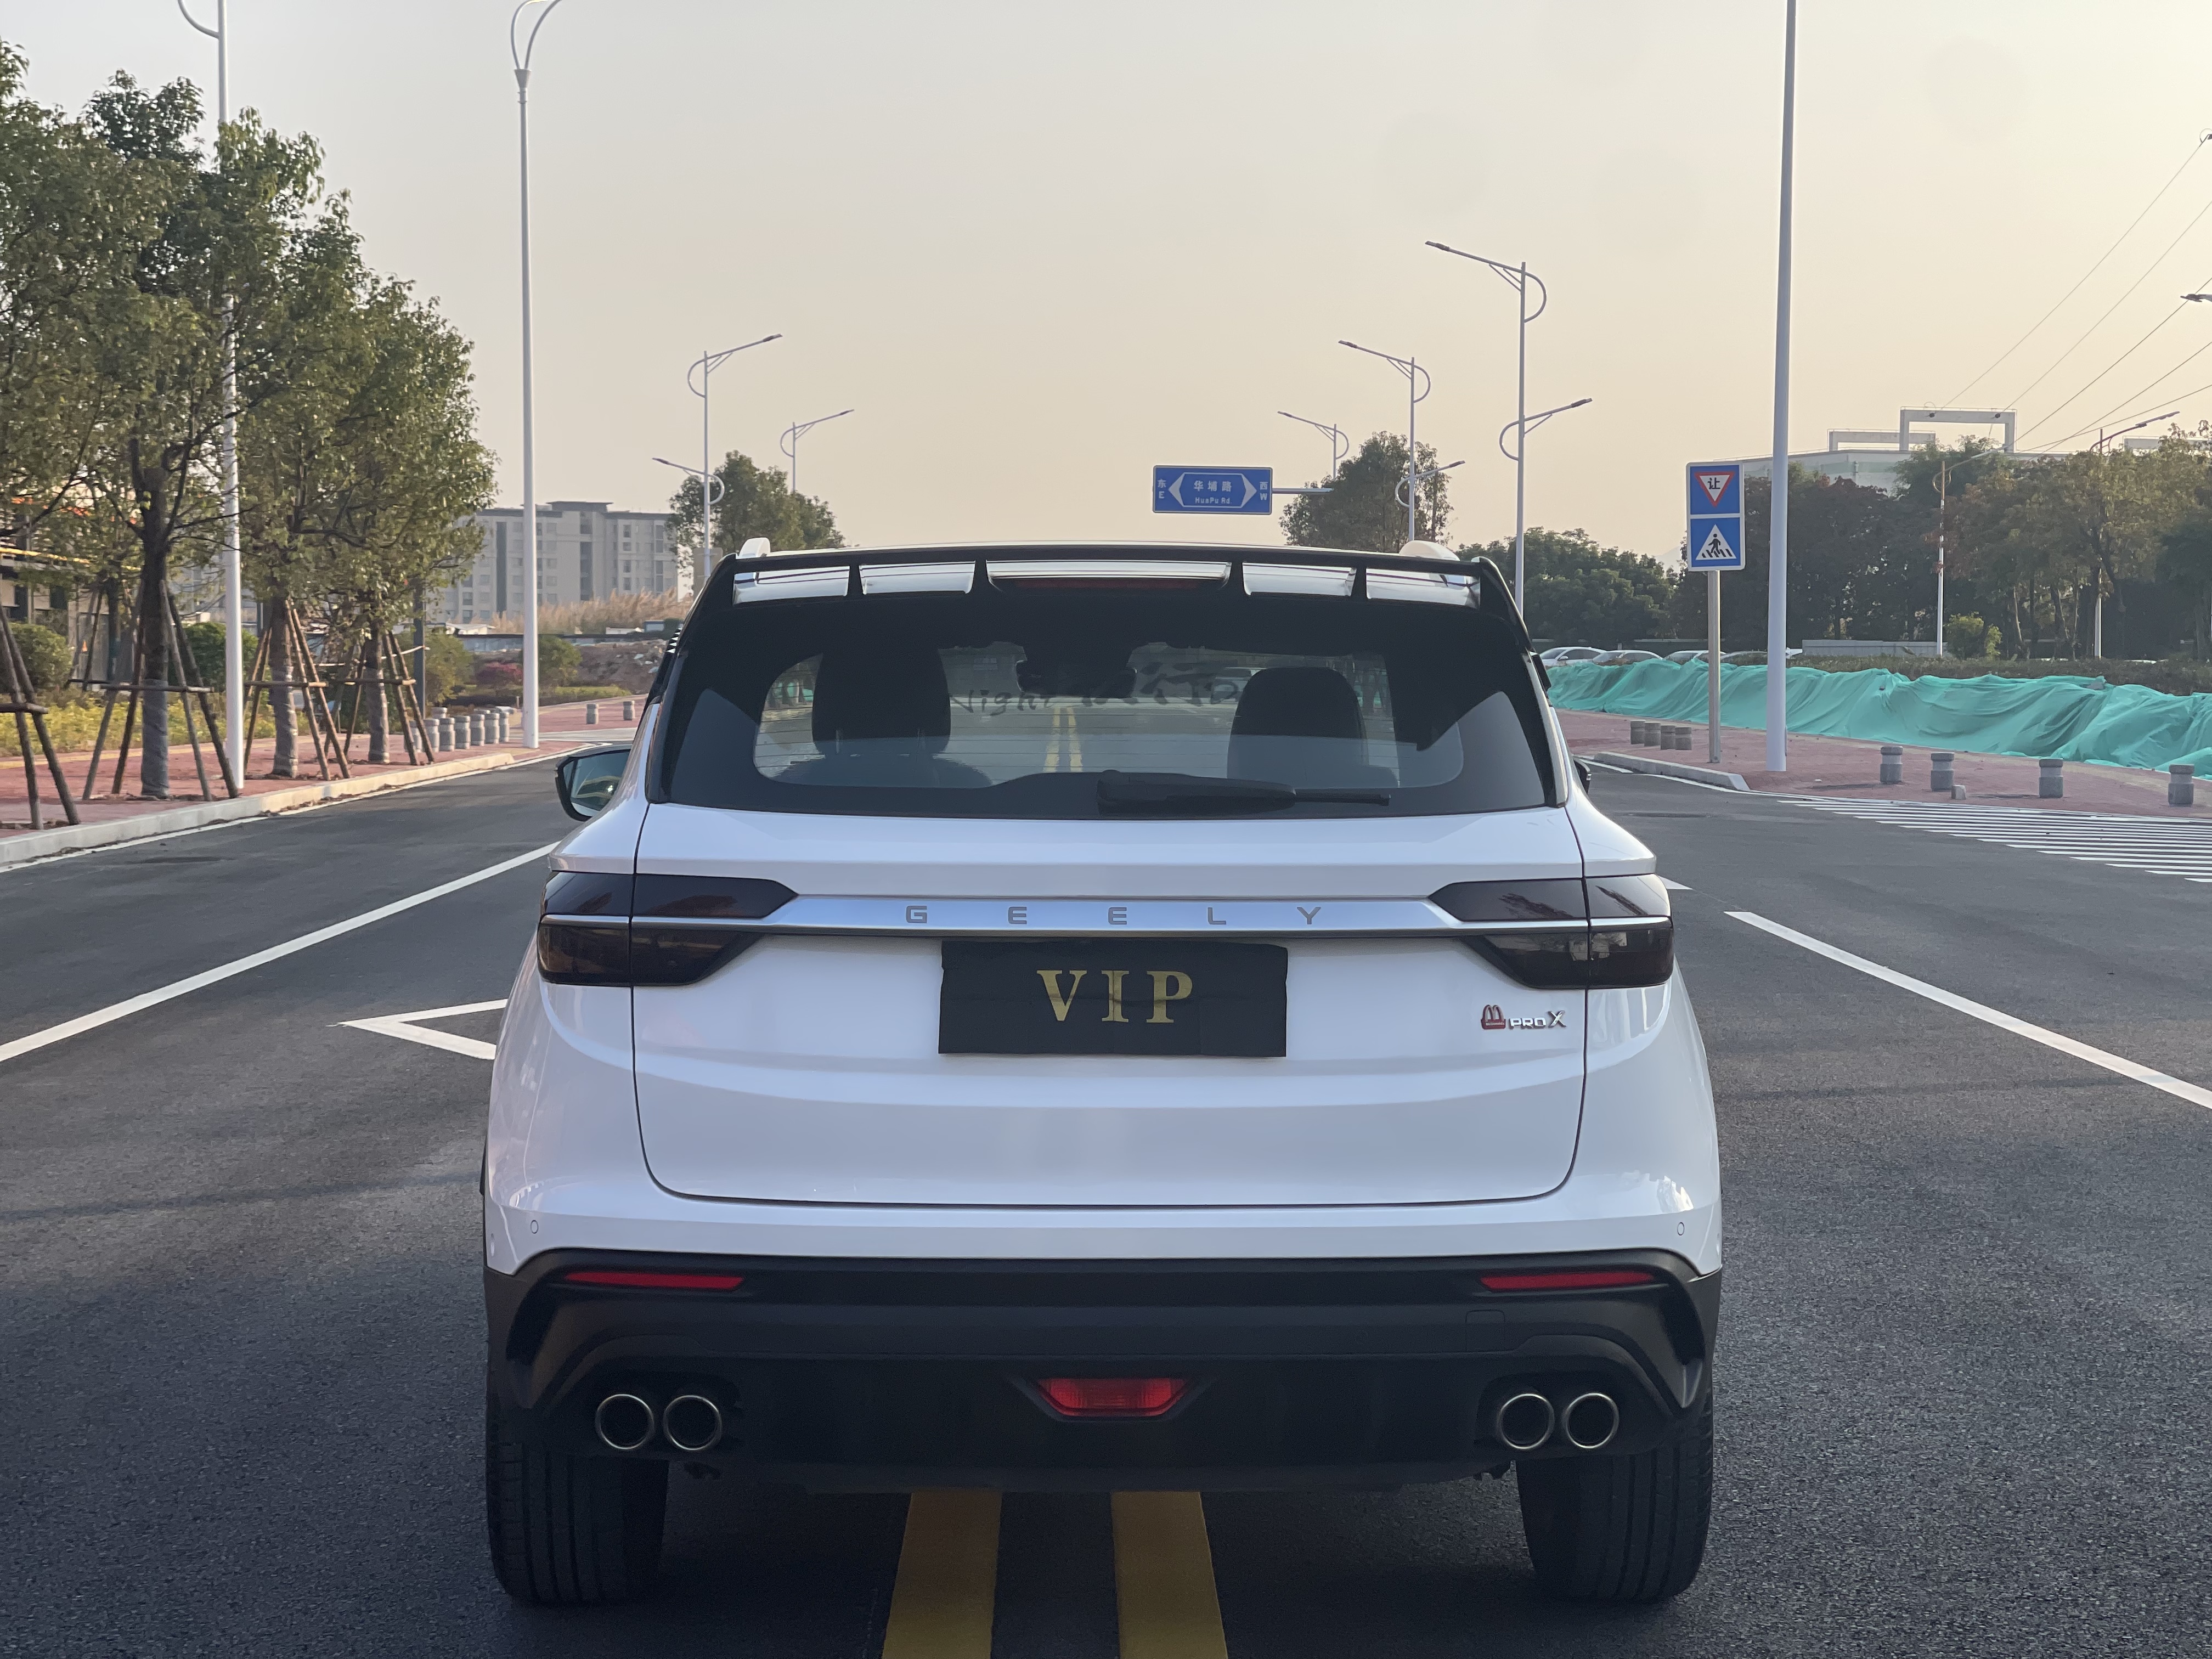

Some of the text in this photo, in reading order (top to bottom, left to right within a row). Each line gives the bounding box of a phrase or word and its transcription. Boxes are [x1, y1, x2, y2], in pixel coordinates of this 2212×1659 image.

[1158, 479, 1166, 488] 东
[1194, 480, 1232, 492] 华埔路
[1259, 481, 1268, 490] 西
[1707, 477, 1720, 490] 让
[905, 905, 1322, 925] GEELY
[1036, 969, 1193, 1024] VIP
